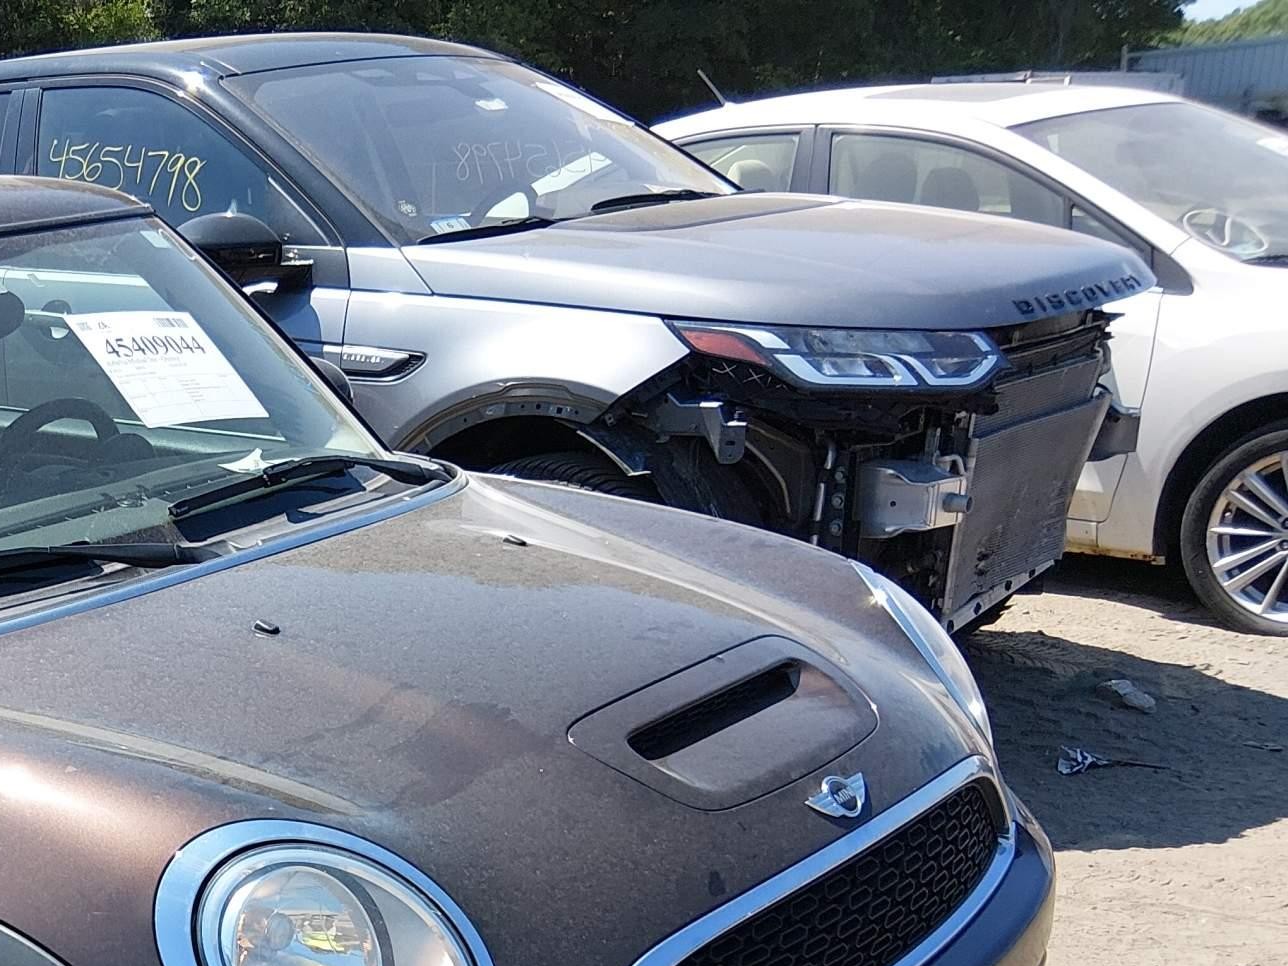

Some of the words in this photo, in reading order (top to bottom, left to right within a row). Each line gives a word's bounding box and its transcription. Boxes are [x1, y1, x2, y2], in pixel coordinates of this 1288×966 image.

[49, 139, 207, 212] 45654798
[104, 335, 207, 359] 45409044
[833, 786, 856, 804] MINI
